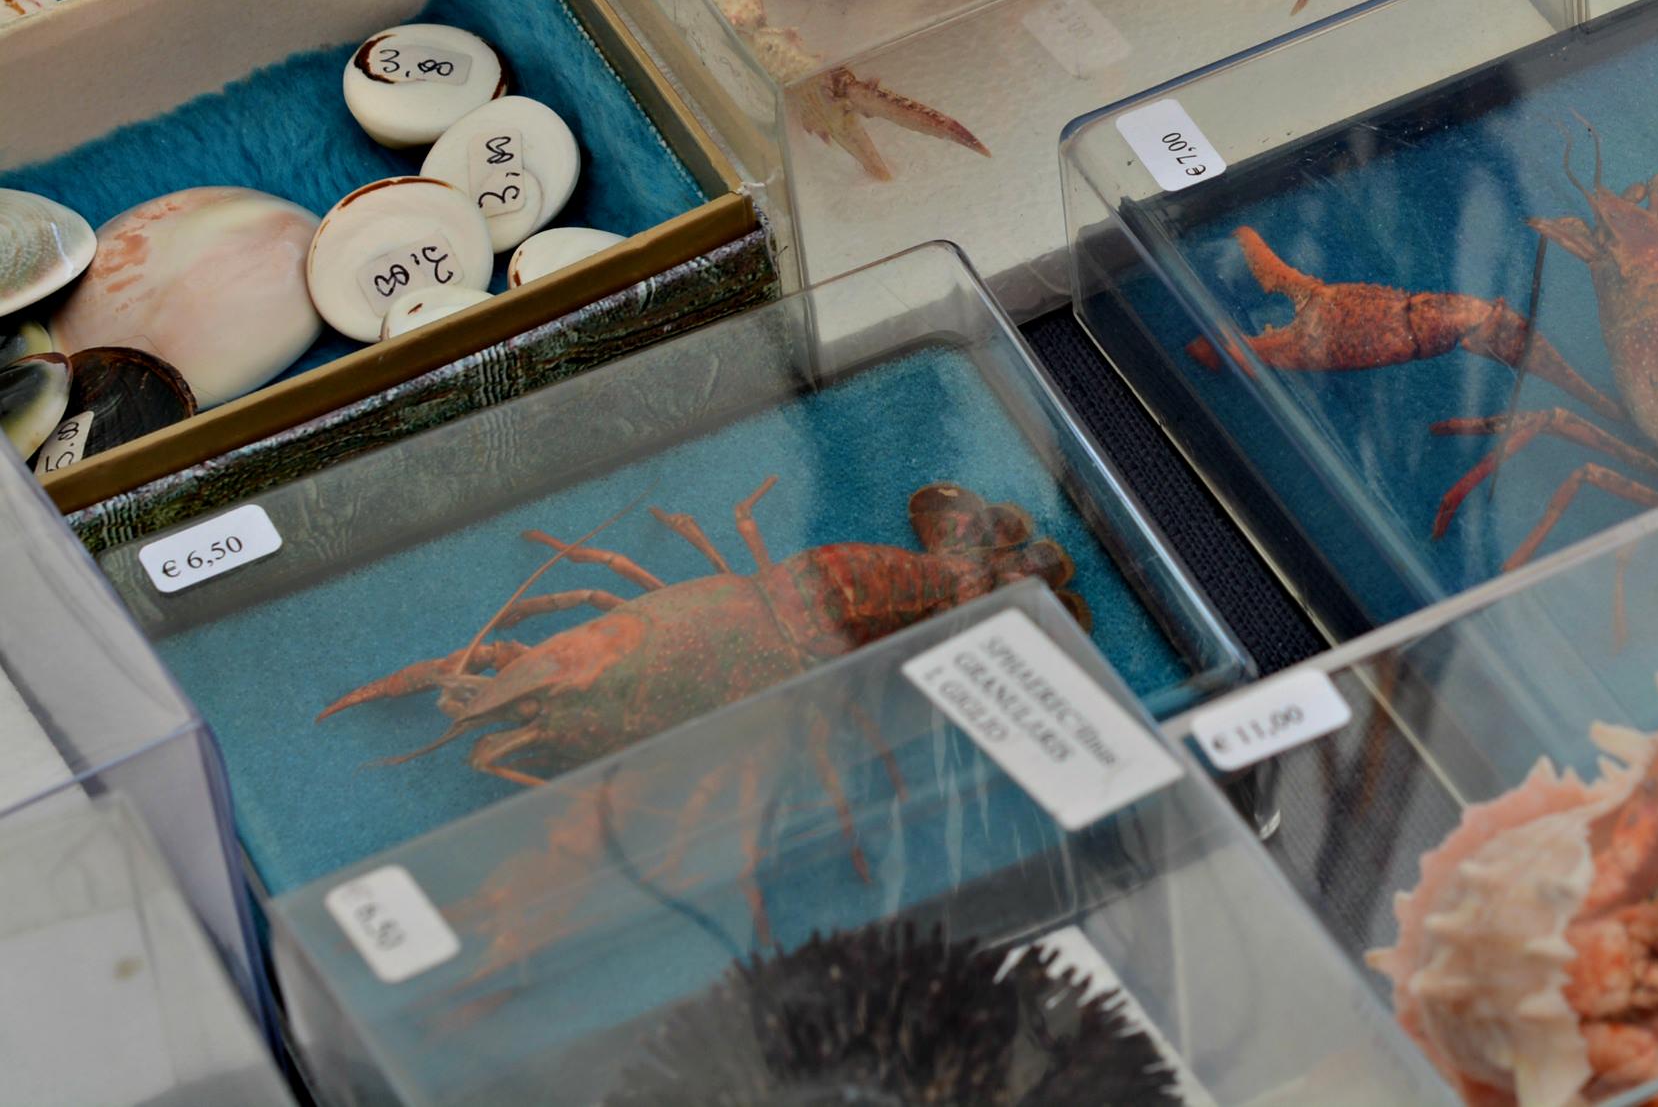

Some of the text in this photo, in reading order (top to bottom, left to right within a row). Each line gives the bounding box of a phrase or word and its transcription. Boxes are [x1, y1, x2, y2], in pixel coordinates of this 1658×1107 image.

[1161, 132, 1198, 165] 7,00
[186, 535, 243, 570] 6,50
[1236, 704, 1304, 745] 11,00
